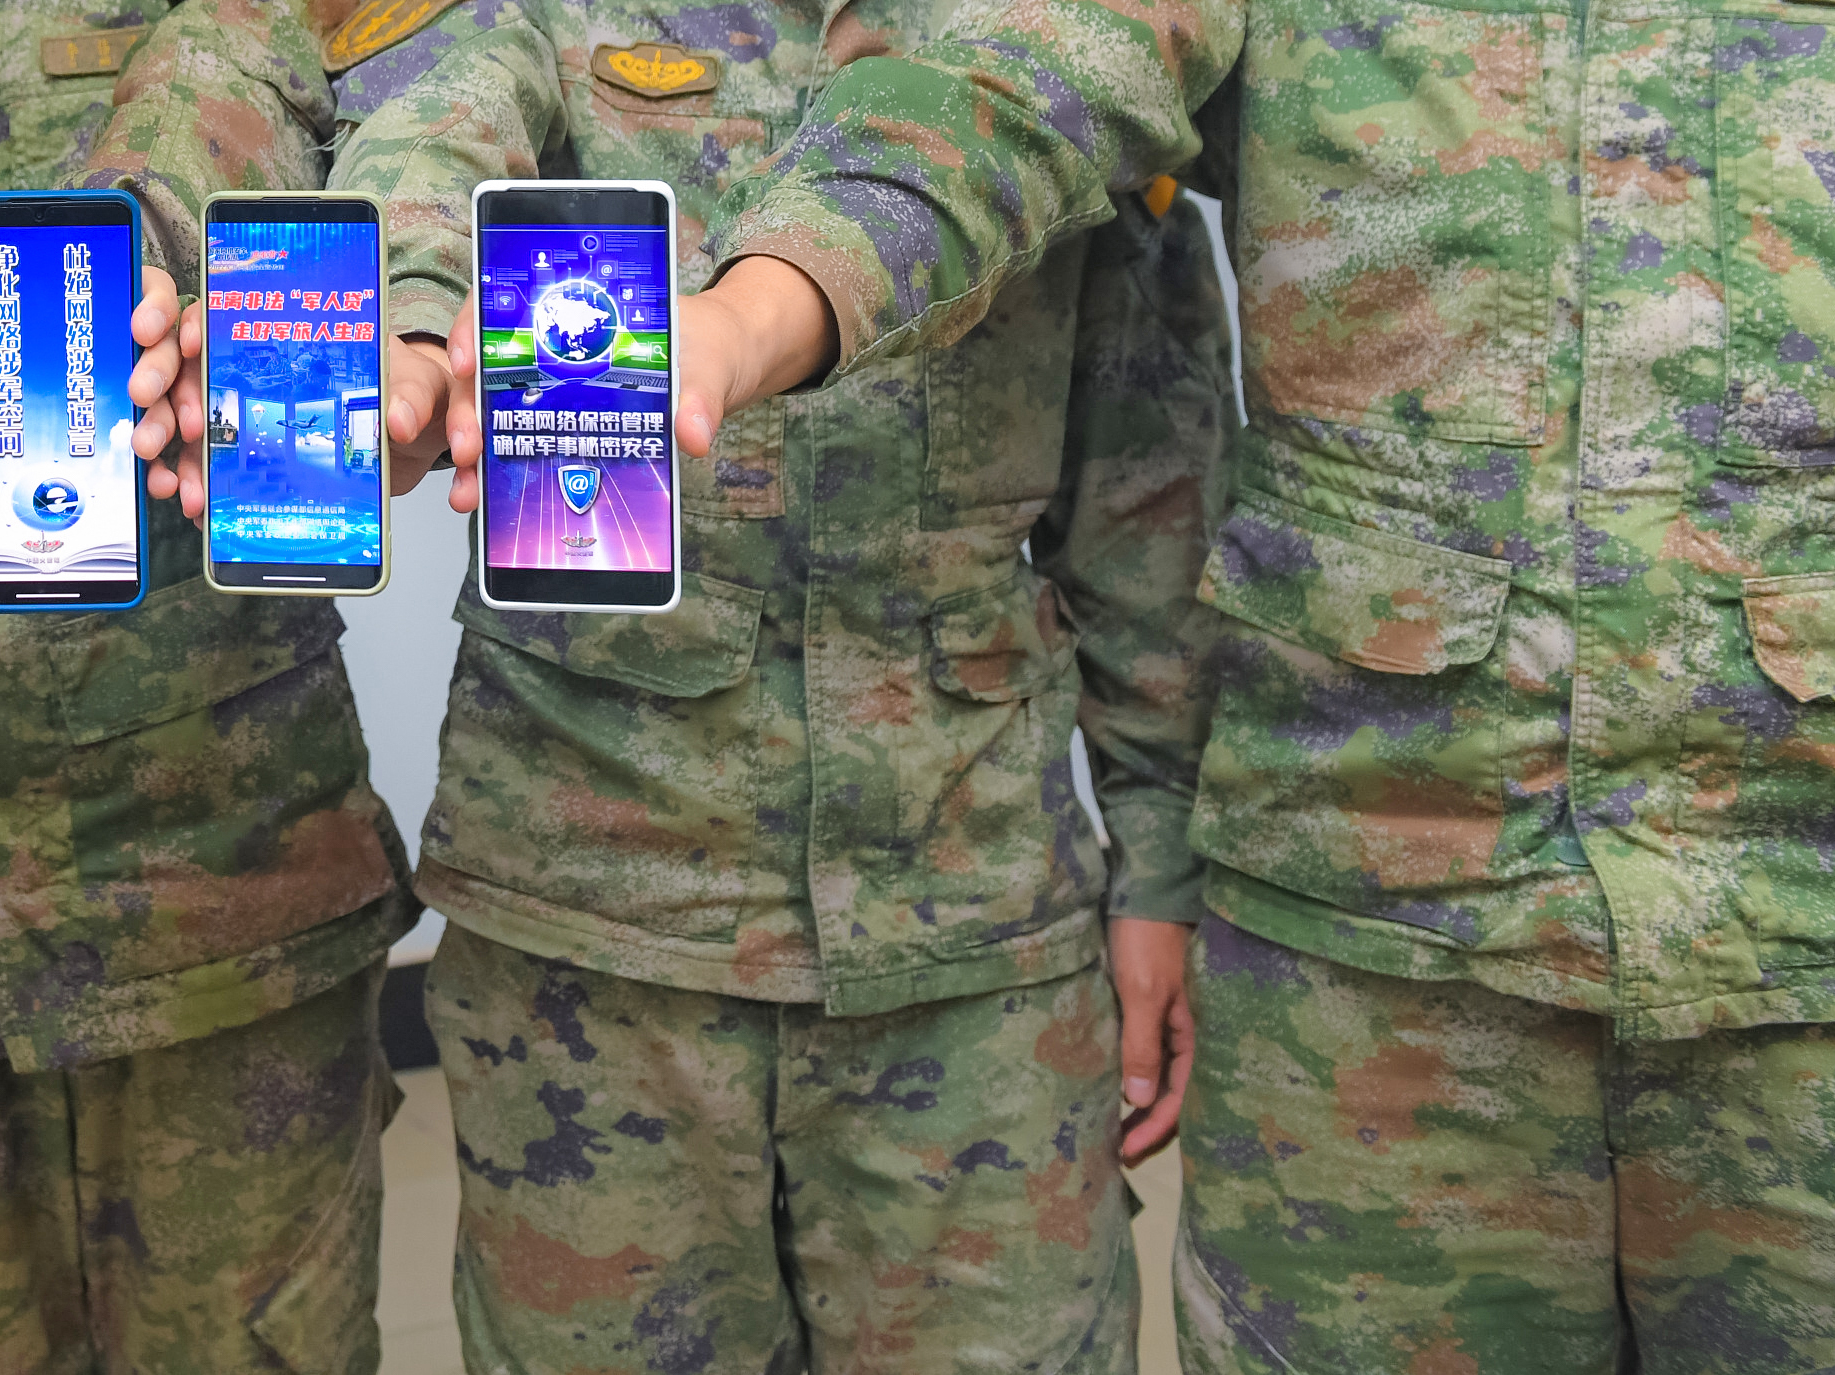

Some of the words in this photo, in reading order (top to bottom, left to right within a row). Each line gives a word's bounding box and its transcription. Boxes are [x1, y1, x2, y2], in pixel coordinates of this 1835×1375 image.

[232, 322, 374, 341] 走好军旅人生路
[63, 243, 96, 457] 杜绝网络涉军谣言
[492, 410, 664, 433] 加强网络保密管理
[493, 435, 664, 459] 确保军事秘密安全
